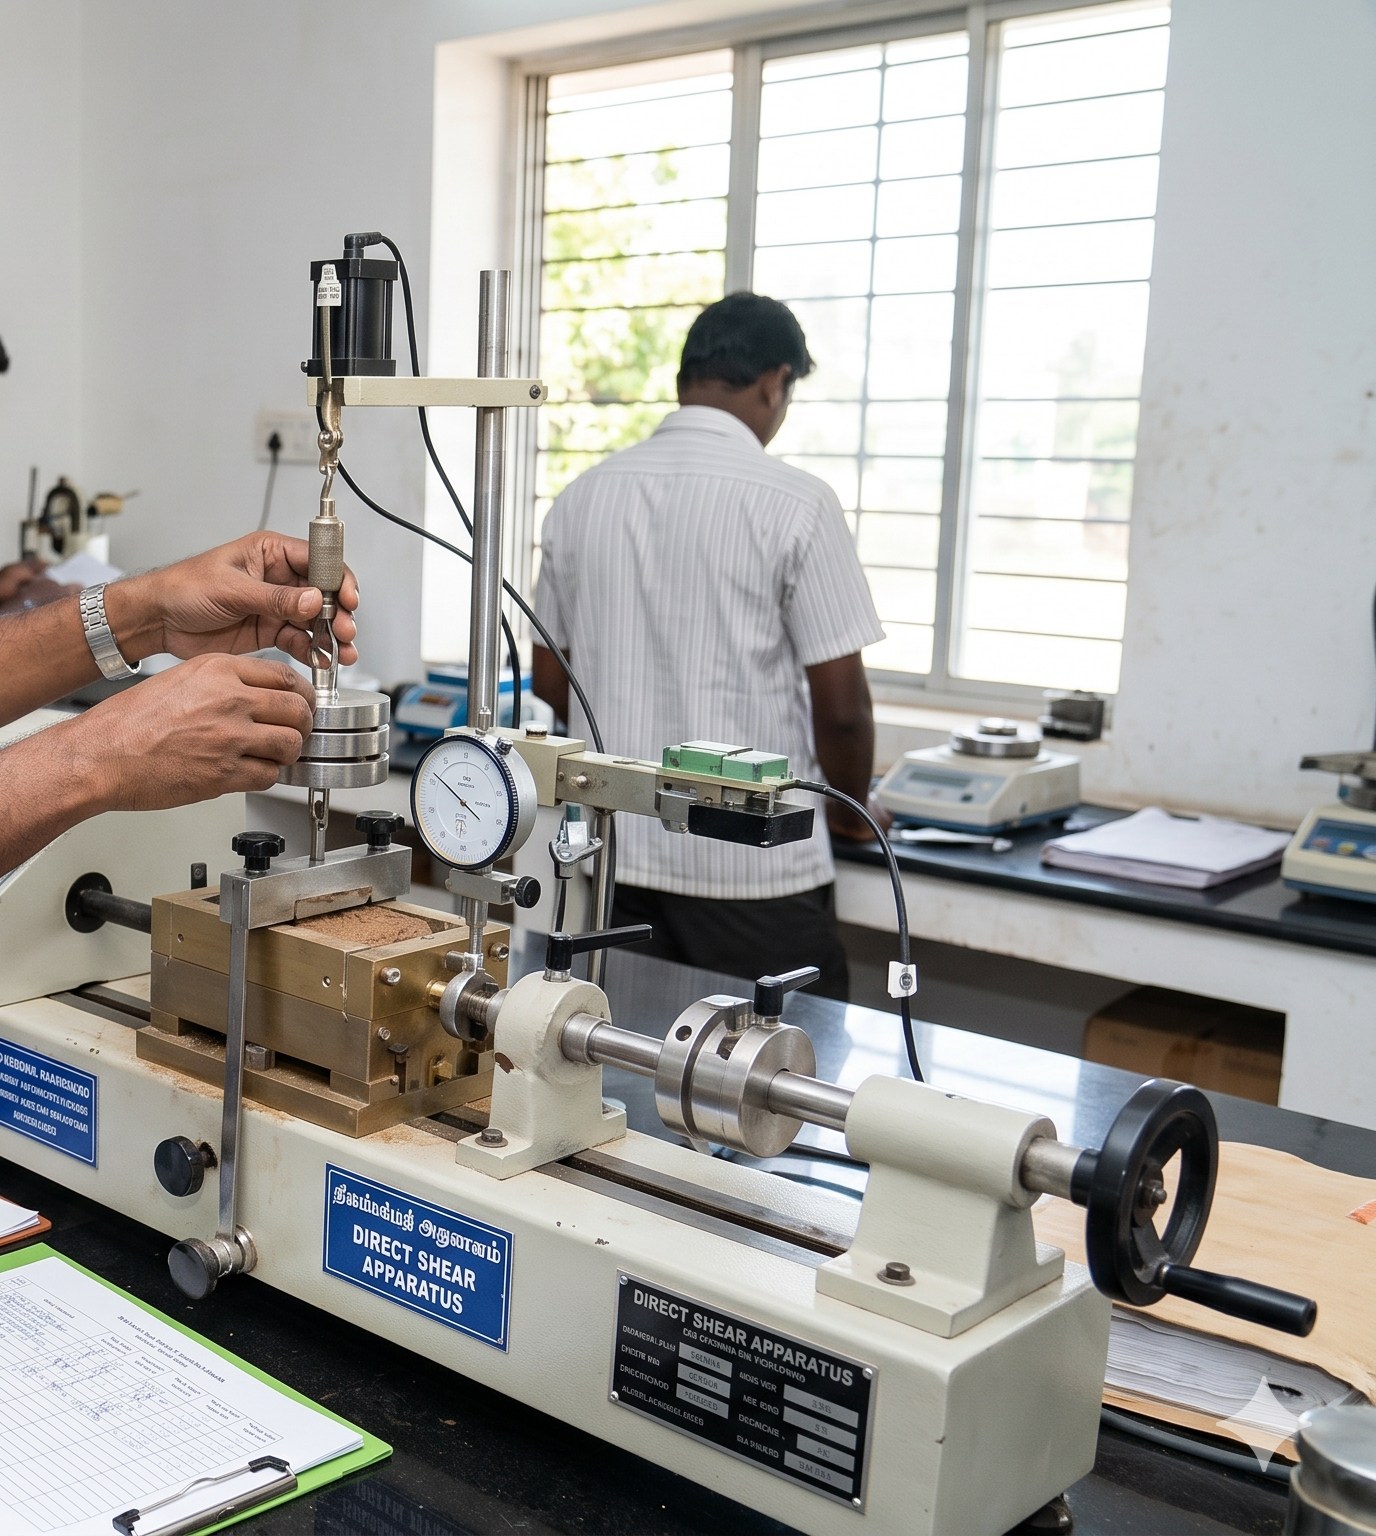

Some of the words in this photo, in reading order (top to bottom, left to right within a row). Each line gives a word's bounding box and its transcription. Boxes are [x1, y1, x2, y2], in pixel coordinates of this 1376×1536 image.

[352, 1223, 414, 1265] DIRECT
[417, 1249, 476, 1292] SHEAR
[361, 1255, 464, 1315] APPARATUS
[633, 1288, 690, 1324] DIRECT
[692, 1311, 747, 1347] SHEAR
[750, 1335, 854, 1388] APPARATUS
